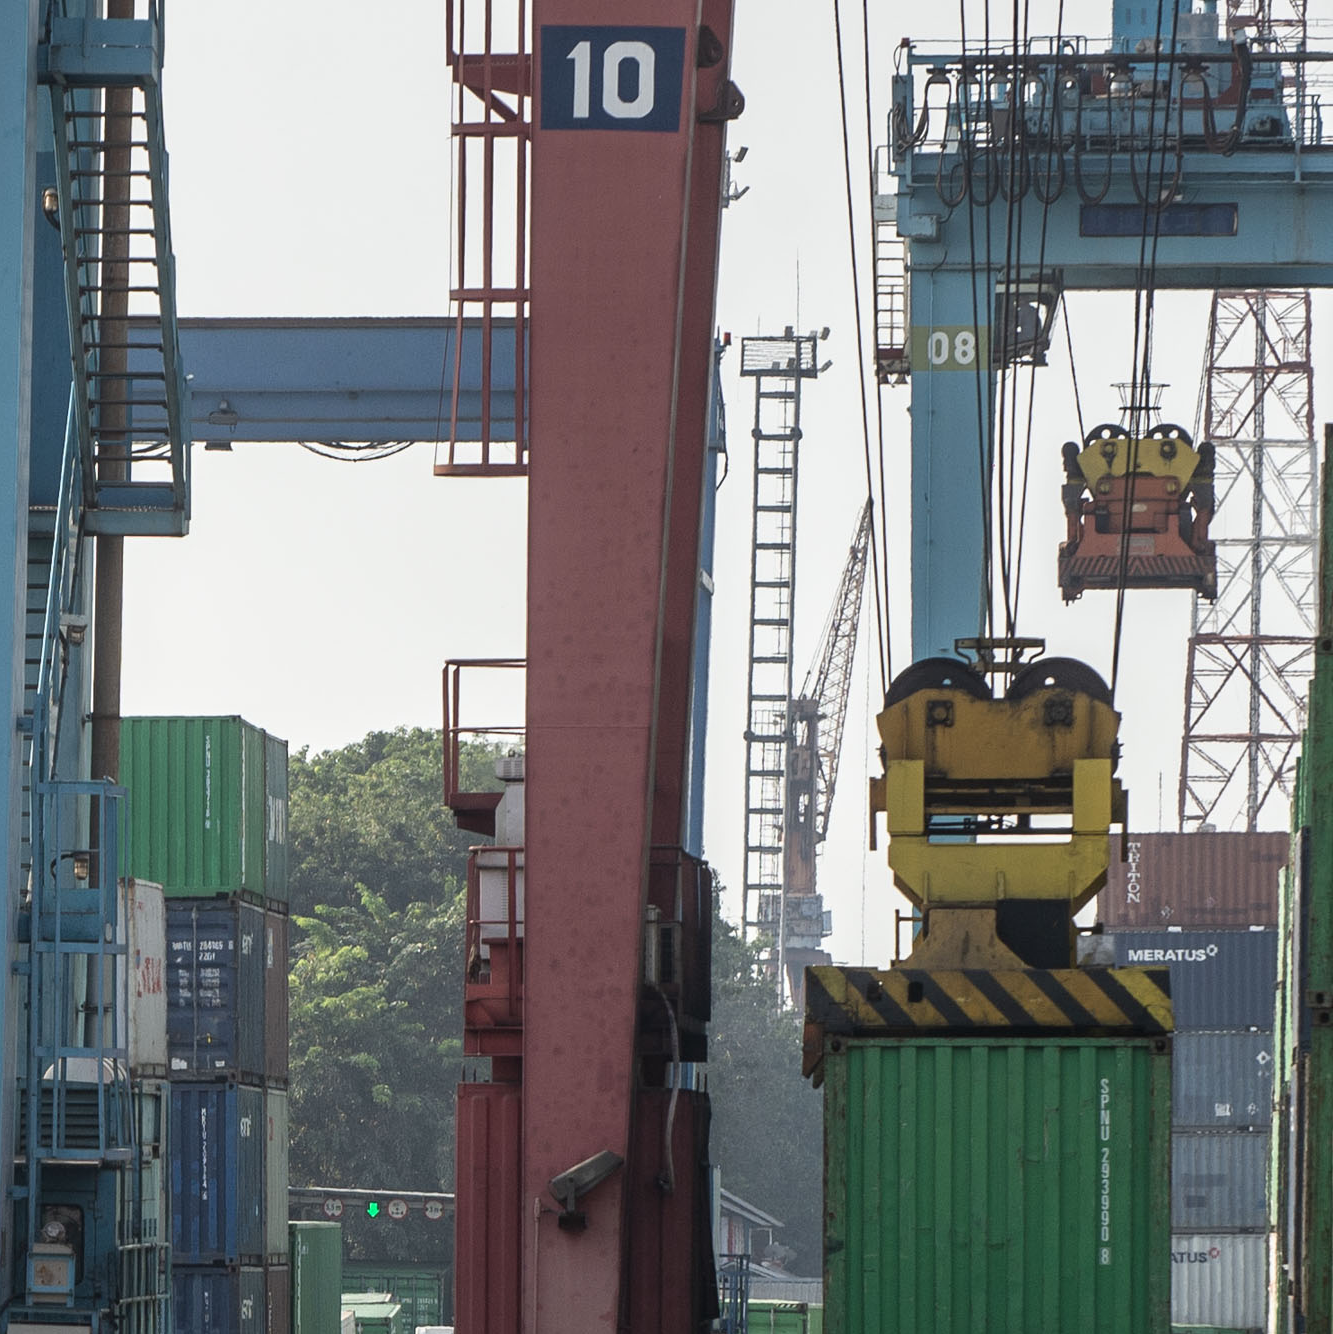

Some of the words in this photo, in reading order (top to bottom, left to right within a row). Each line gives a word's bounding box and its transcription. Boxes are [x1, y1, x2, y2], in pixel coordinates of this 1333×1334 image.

[566, 41, 655, 118] 10
[928, 331, 975, 365] 08
[1126, 842, 1141, 903] TRITON
[1128, 949, 1206, 962] MERATUS
[1100, 1078, 1110, 1141] SPNU
[1100, 1147, 1110, 1242] 293990
[1100, 1248, 1110, 1265] 8
